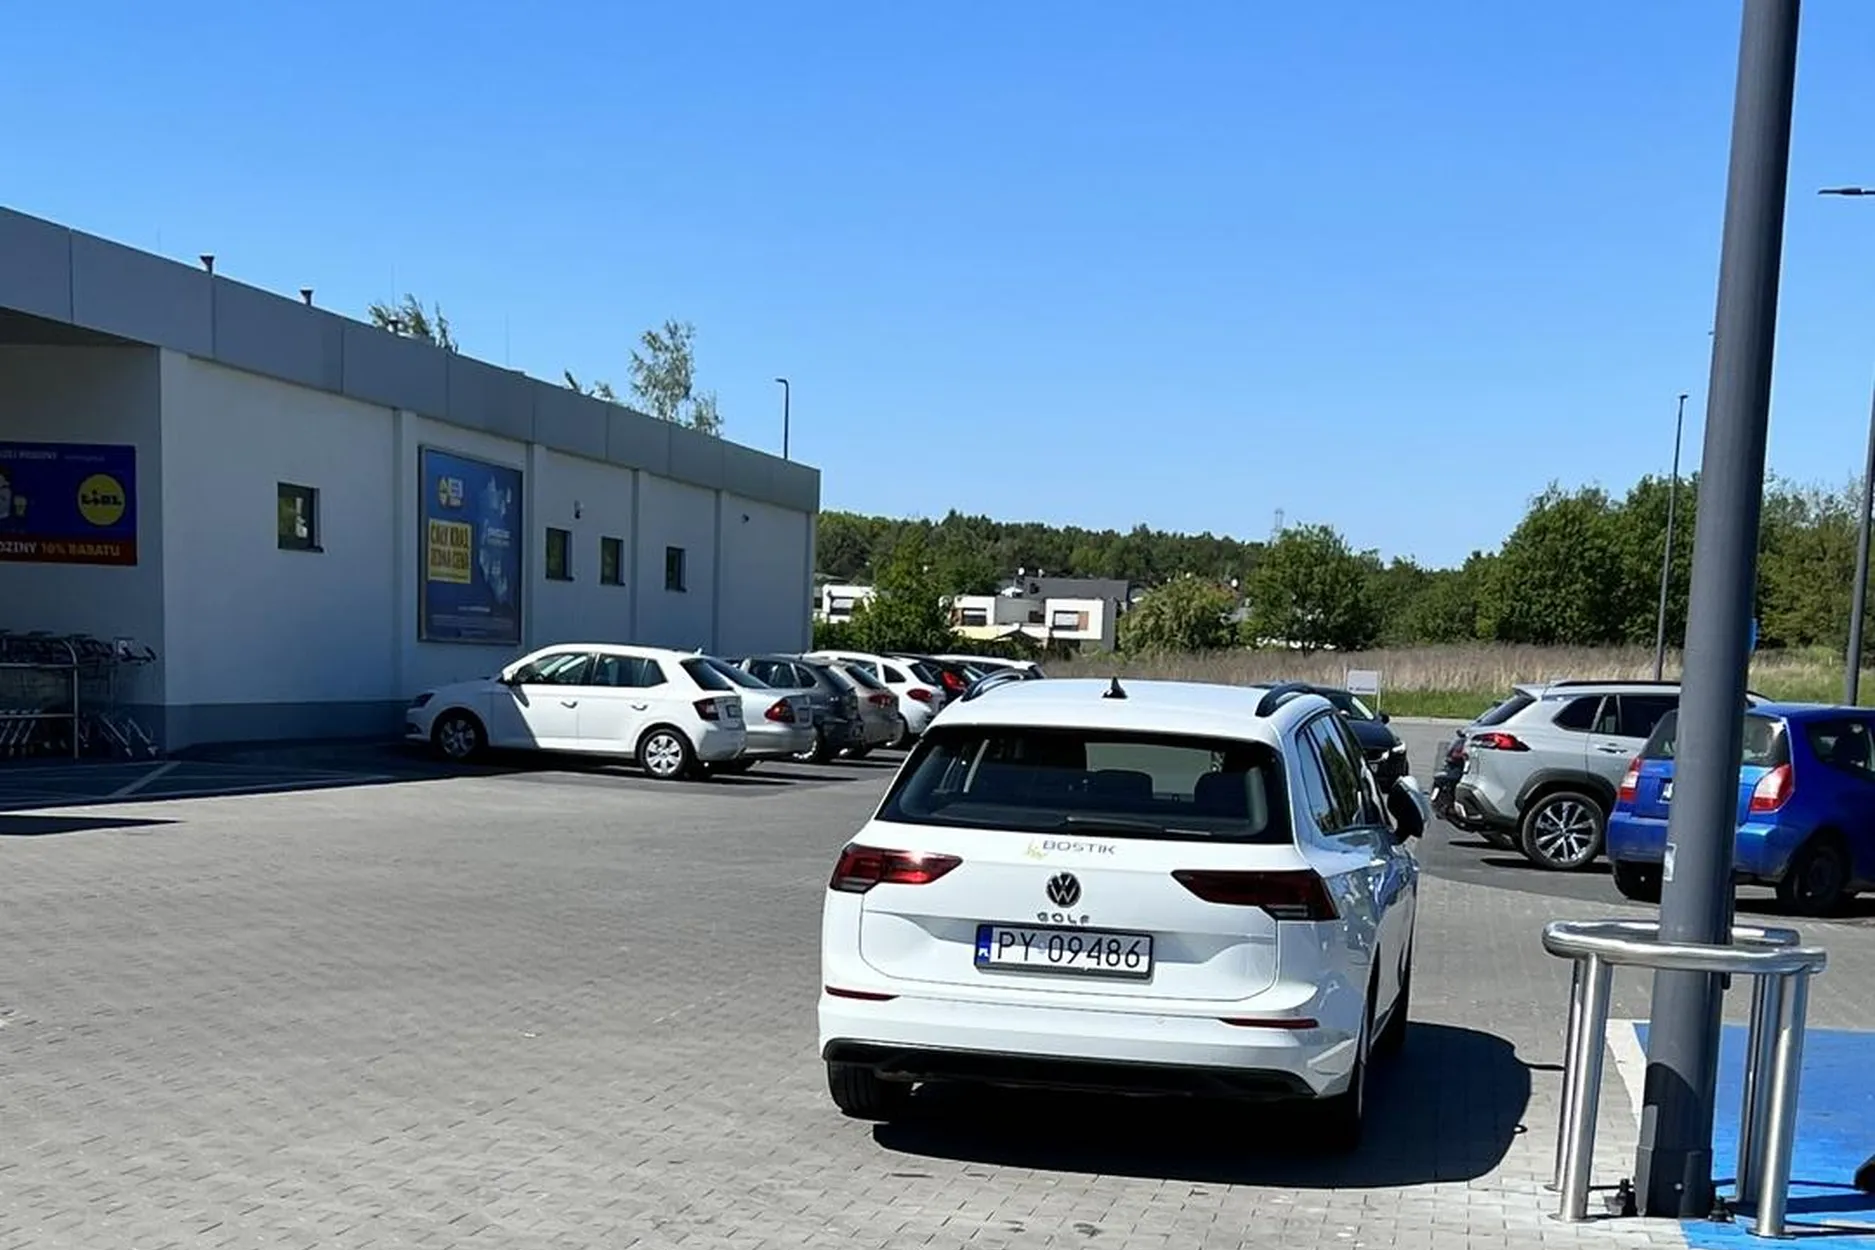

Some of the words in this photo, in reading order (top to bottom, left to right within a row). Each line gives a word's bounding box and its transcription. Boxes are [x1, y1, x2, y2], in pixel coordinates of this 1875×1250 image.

[1036, 911, 1091, 925] GOLF
[997, 931, 1037, 961] PY
[1047, 934, 1141, 968] 09486
